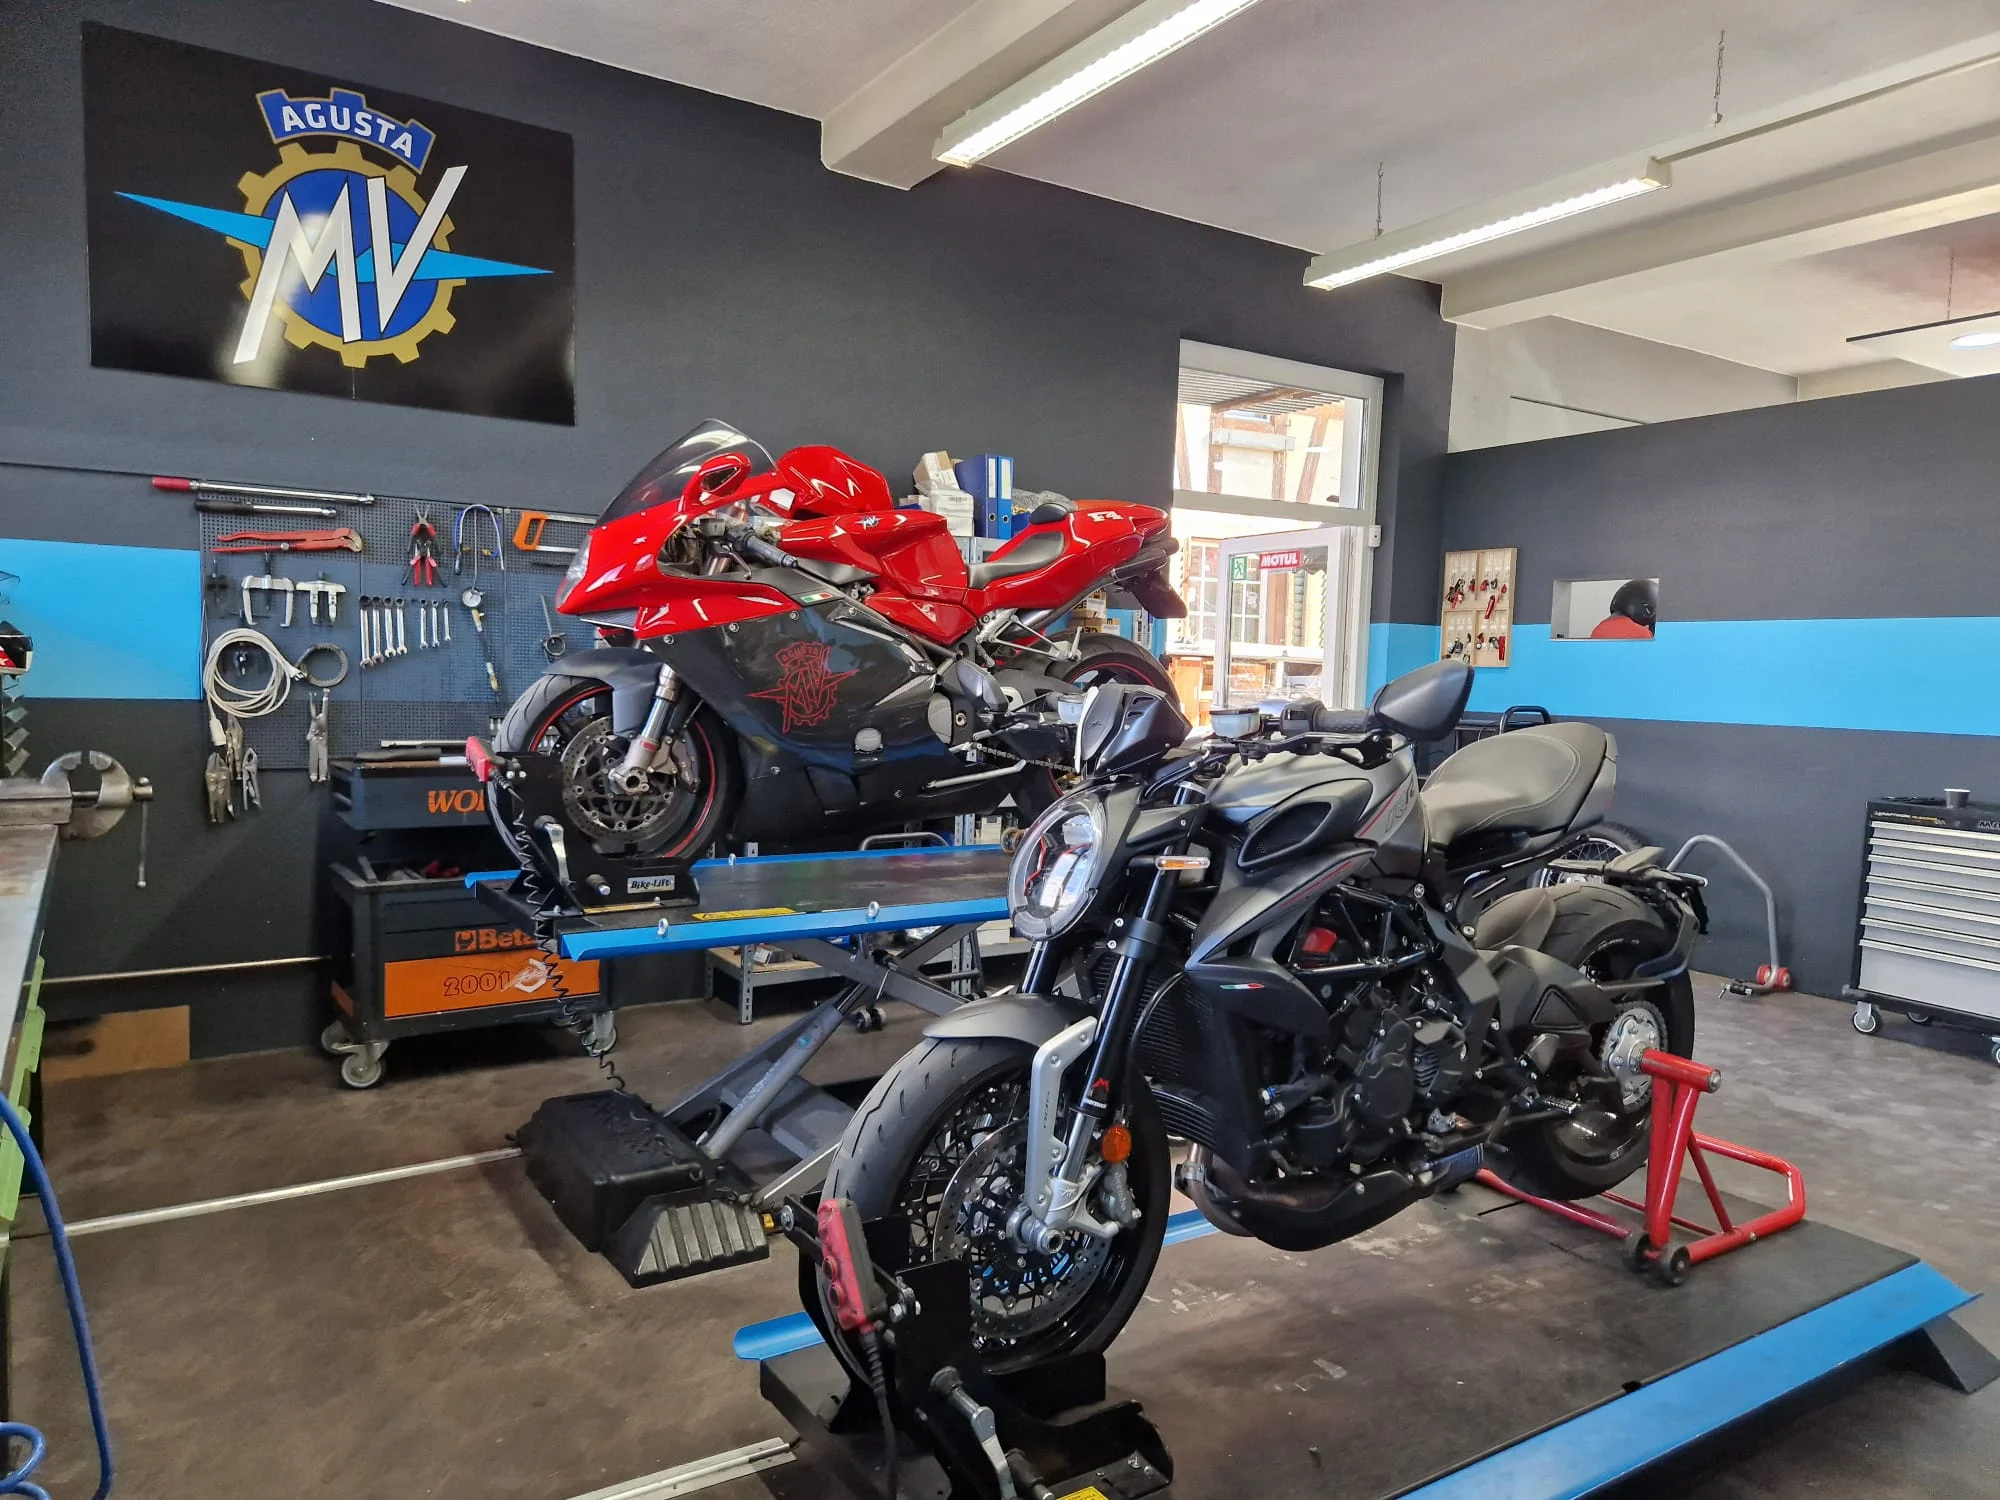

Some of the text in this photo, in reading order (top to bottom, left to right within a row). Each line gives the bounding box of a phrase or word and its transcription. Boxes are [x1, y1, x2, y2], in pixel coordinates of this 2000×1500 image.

[281, 103, 413, 159] AGUSTA
[232, 164, 469, 365] MV
[1087, 510, 1124, 522] F4
[1260, 552, 1298, 567] MOTUL
